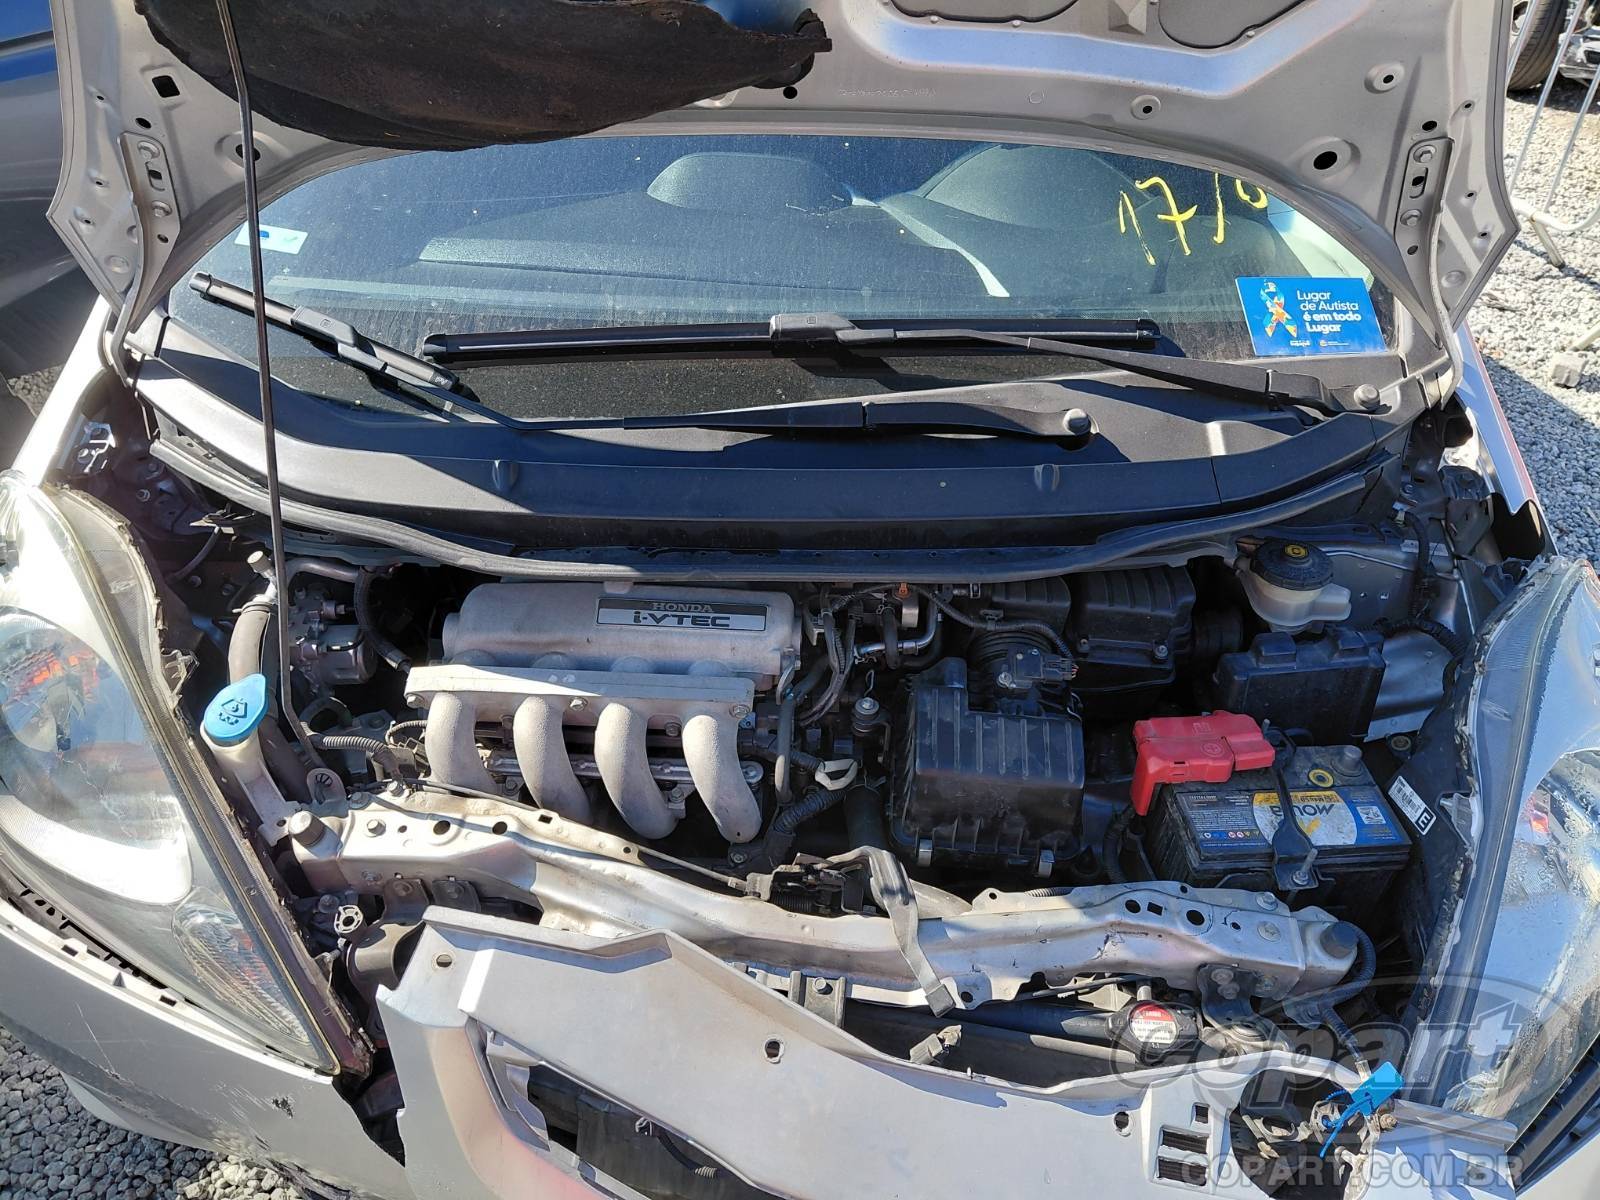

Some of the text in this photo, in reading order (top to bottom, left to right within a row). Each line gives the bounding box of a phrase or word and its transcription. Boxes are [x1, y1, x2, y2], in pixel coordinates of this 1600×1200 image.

[1297, 290, 1331, 302] Lugar
[1300, 301, 1359, 311] de Autista
[1303, 312, 1311, 321] é
[1333, 311, 1362, 321] todo
[1306, 322, 1341, 334] Lugar
[651, 602, 715, 613] HONDA
[633, 611, 730, 628] i-VTEC
